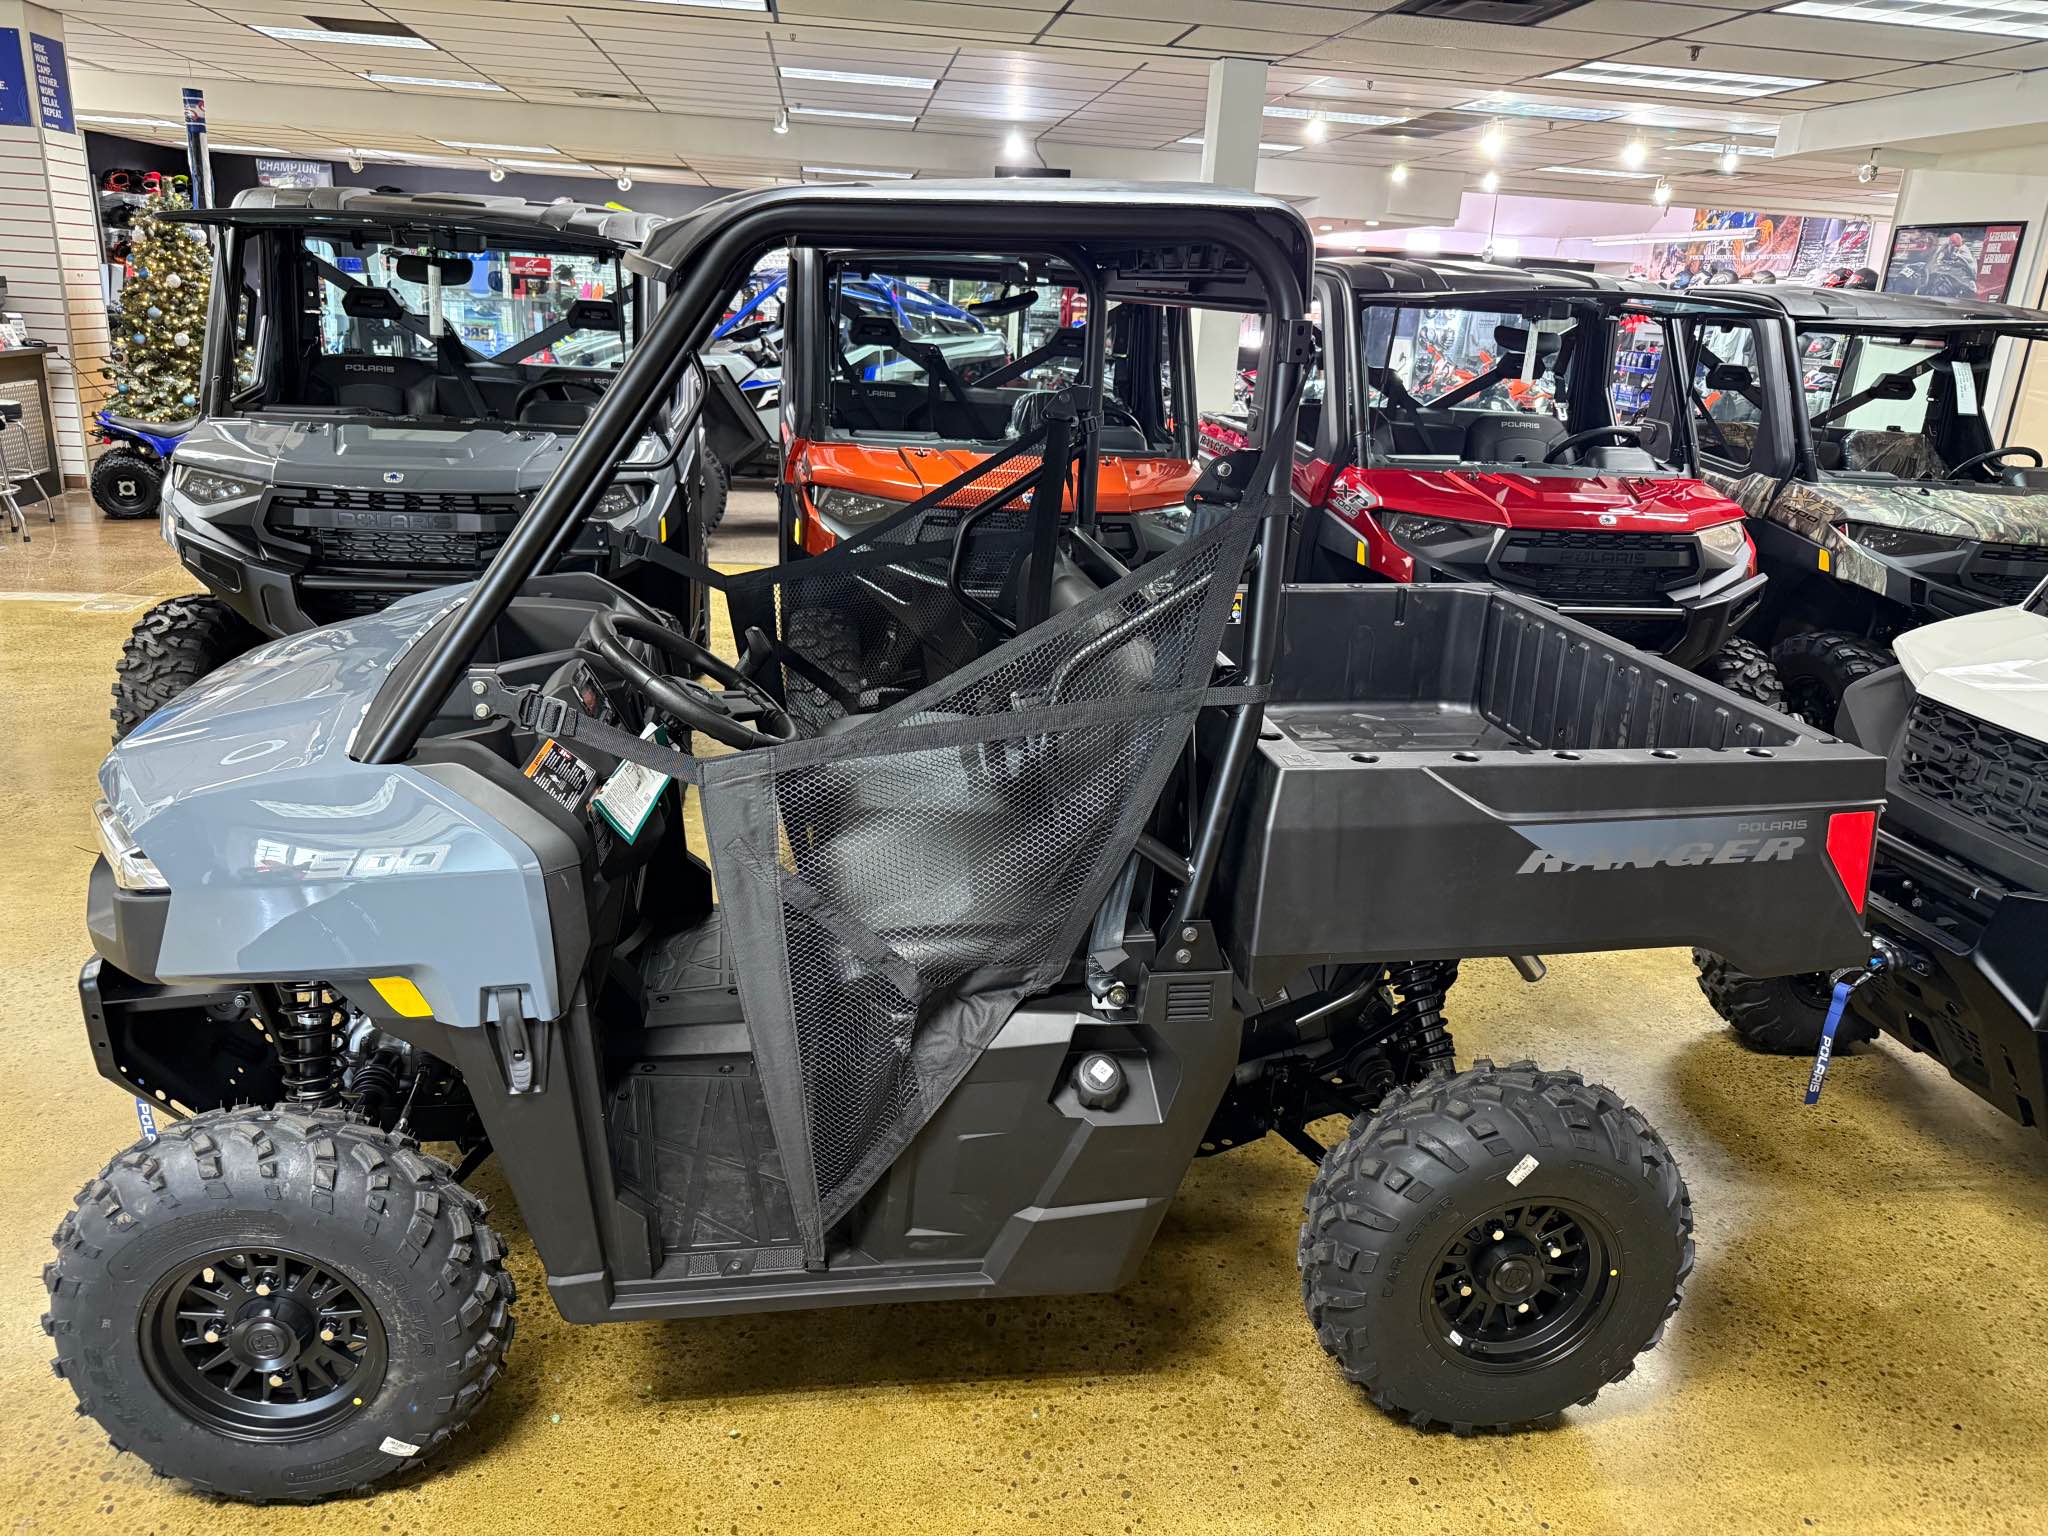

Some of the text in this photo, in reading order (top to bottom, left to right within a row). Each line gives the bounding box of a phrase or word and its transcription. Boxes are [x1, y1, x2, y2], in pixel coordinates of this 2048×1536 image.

[36, 64, 52, 76] CAMP.
[344, 364, 395, 373] POLARIS
[1501, 421, 1540, 429] POLARIS
[1332, 483, 1369, 508] XP
[1781, 491, 1836, 515] XP
[1334, 497, 1360, 519] 1000
[1783, 504, 1819, 523] 1000
[337, 512, 454, 530] POLARIS
[1560, 550, 1647, 565] POLARIS
[1738, 819, 1807, 832] POLARIS
[1516, 836, 1806, 874] RANGER
[1809, 1035, 1832, 1093] POLARIS
